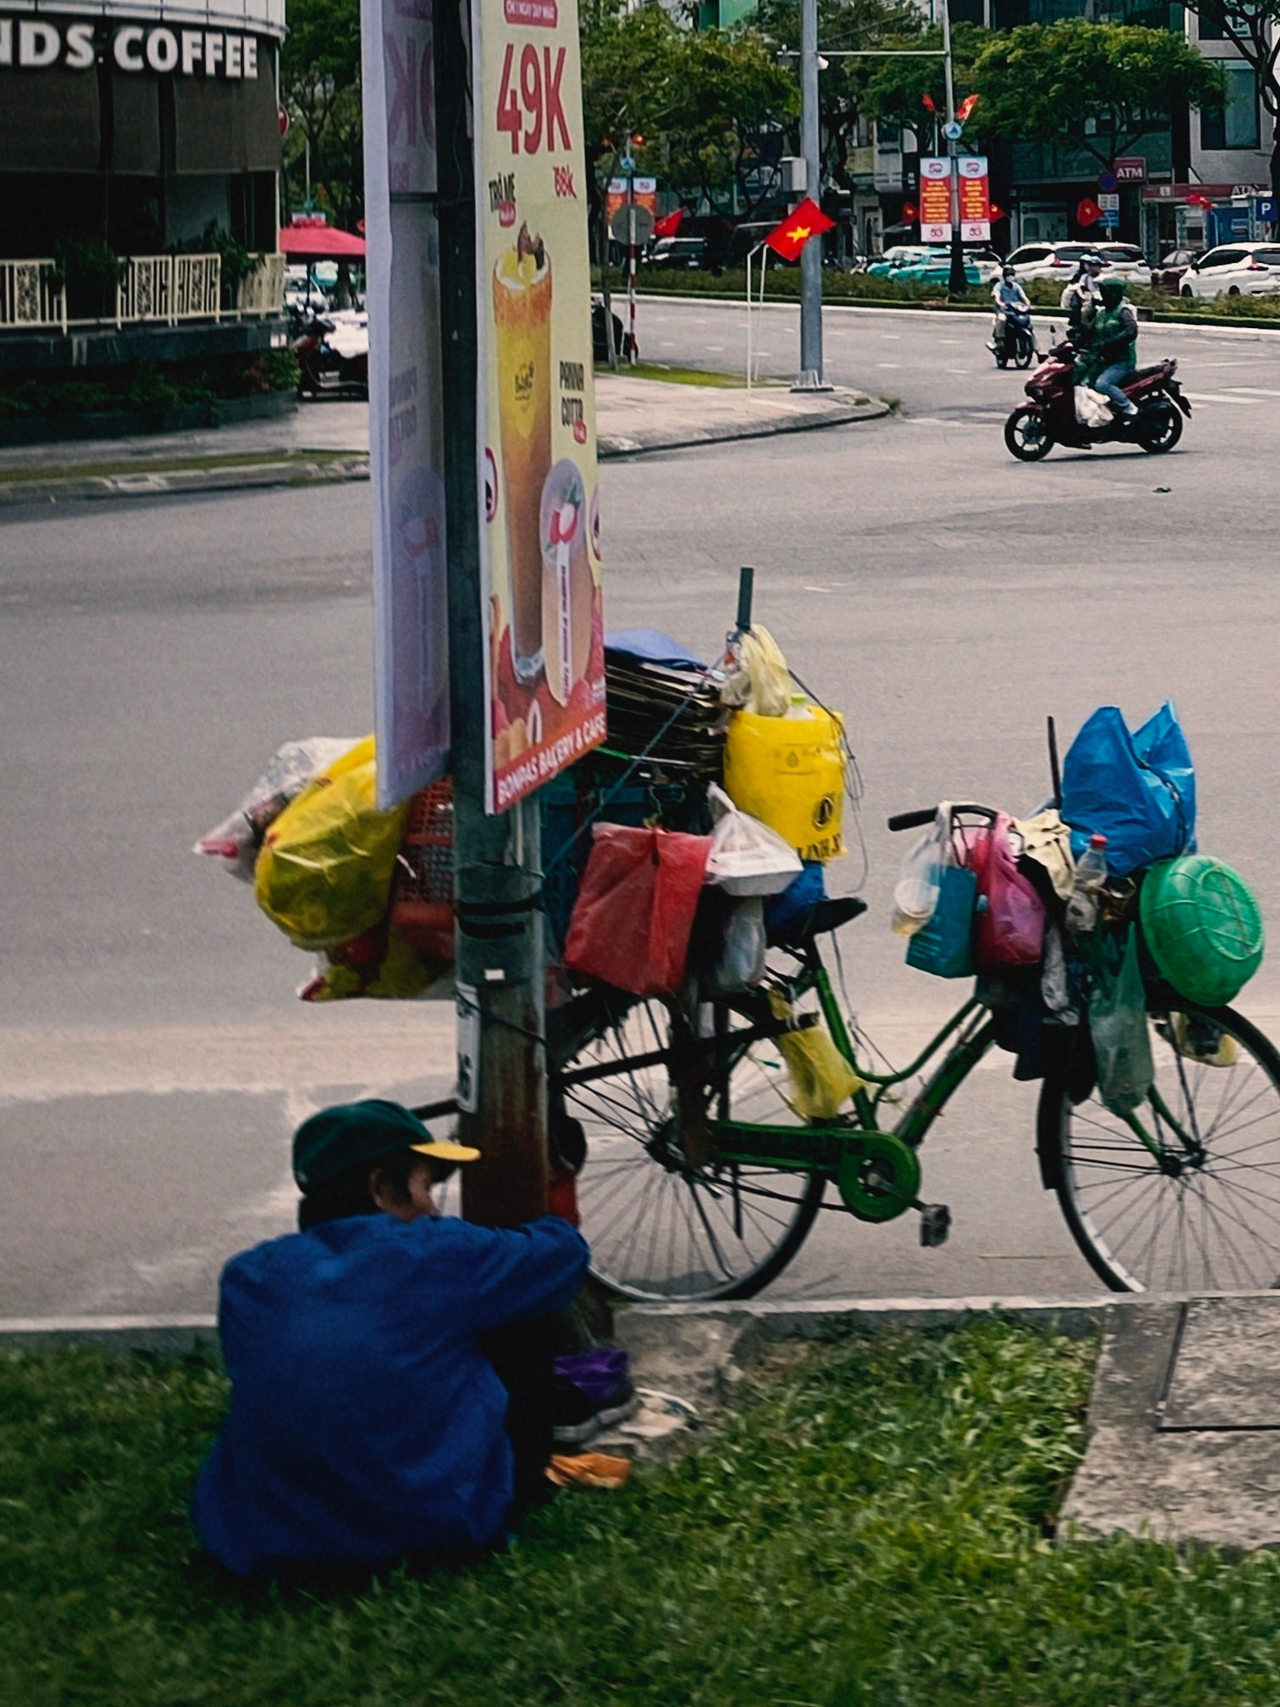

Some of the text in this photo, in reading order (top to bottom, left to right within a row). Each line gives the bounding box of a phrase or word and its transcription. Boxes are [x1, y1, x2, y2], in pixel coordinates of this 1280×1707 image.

[113, 26, 258, 79] COFFEE
[497, 43, 571, 155] 49K
[1116, 167, 1143, 179] ATM
[1261, 202, 1271, 215] P
